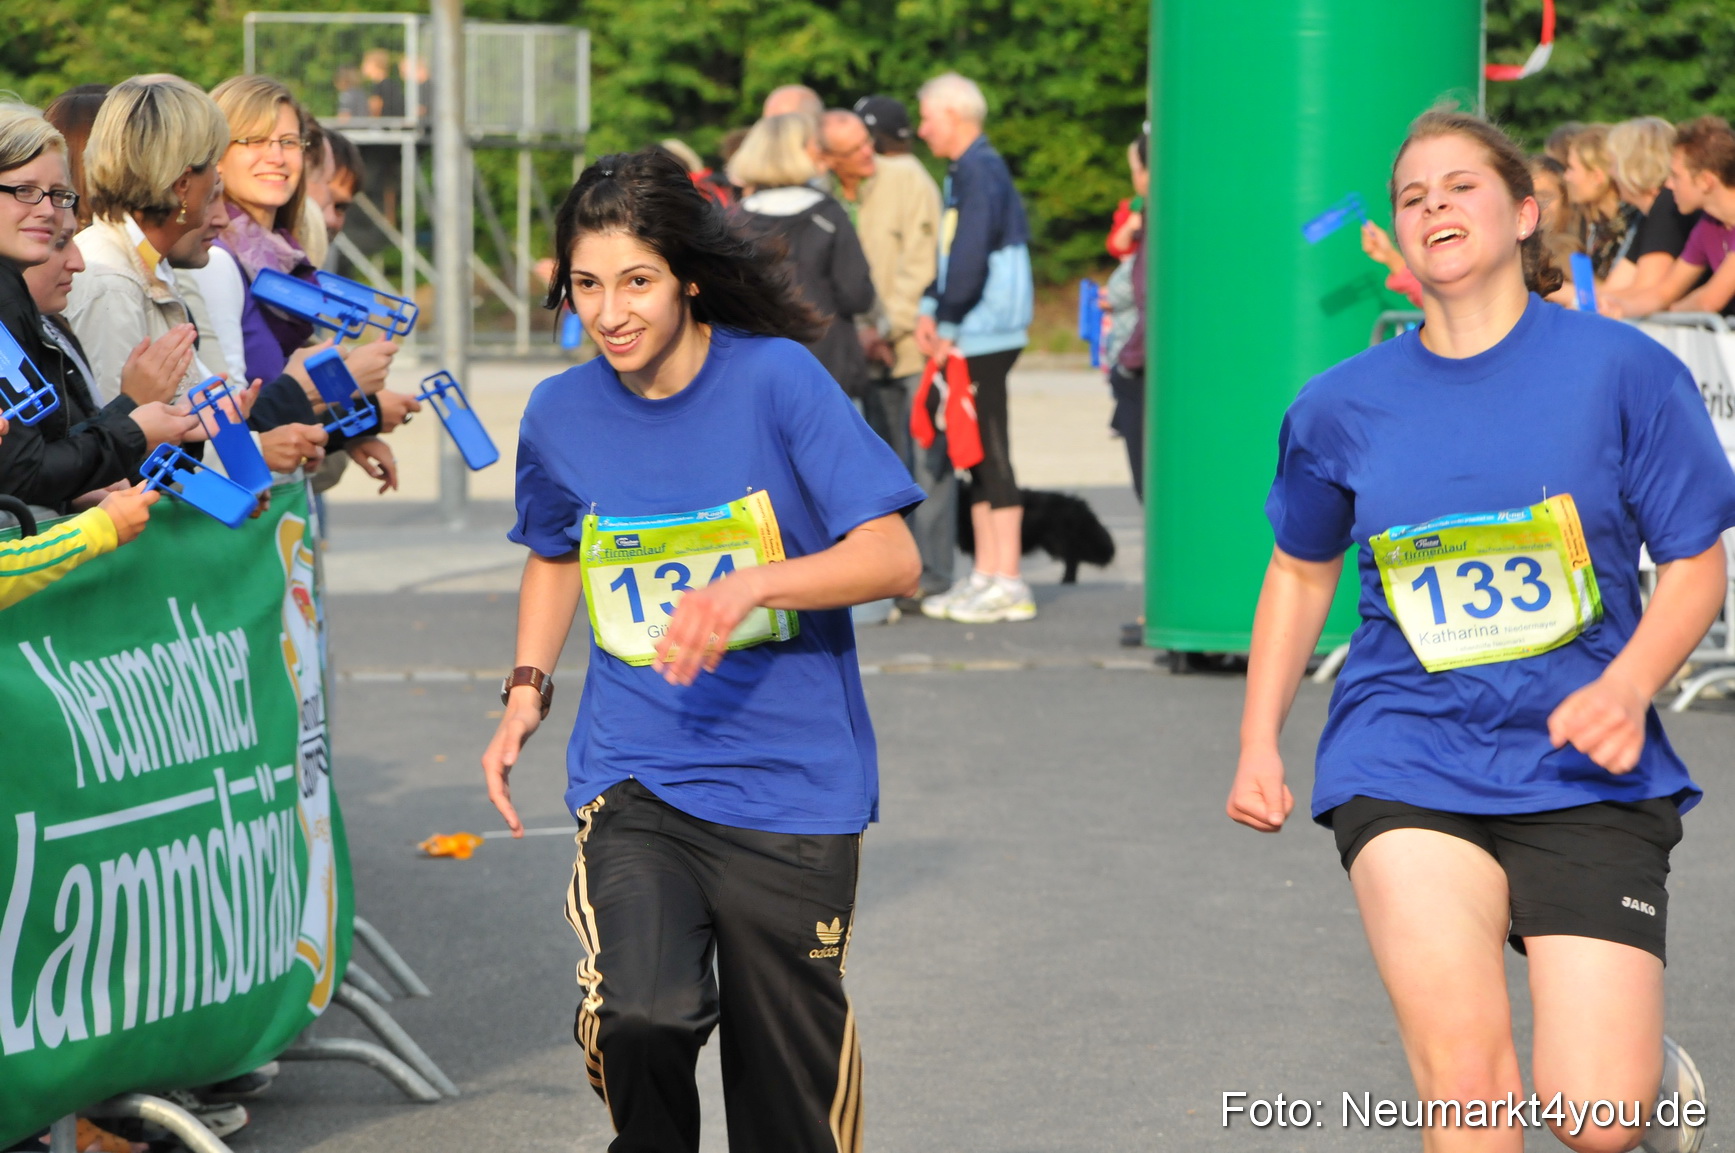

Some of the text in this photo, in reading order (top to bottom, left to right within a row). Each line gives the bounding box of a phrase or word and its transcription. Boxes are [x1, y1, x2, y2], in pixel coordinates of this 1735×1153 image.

[604, 543, 666, 559] firmenlauf
[1403, 541, 1468, 561] firmenlauf
[1411, 556, 1552, 626] 133
[1419, 620, 1557, 646] Katharina Niedermayer
[19, 597, 258, 788] Neumarkter
[0, 767, 298, 1056] Lammsbräu
[1621, 896, 1656, 916] JAKO
[809, 945, 840, 959] adidas
